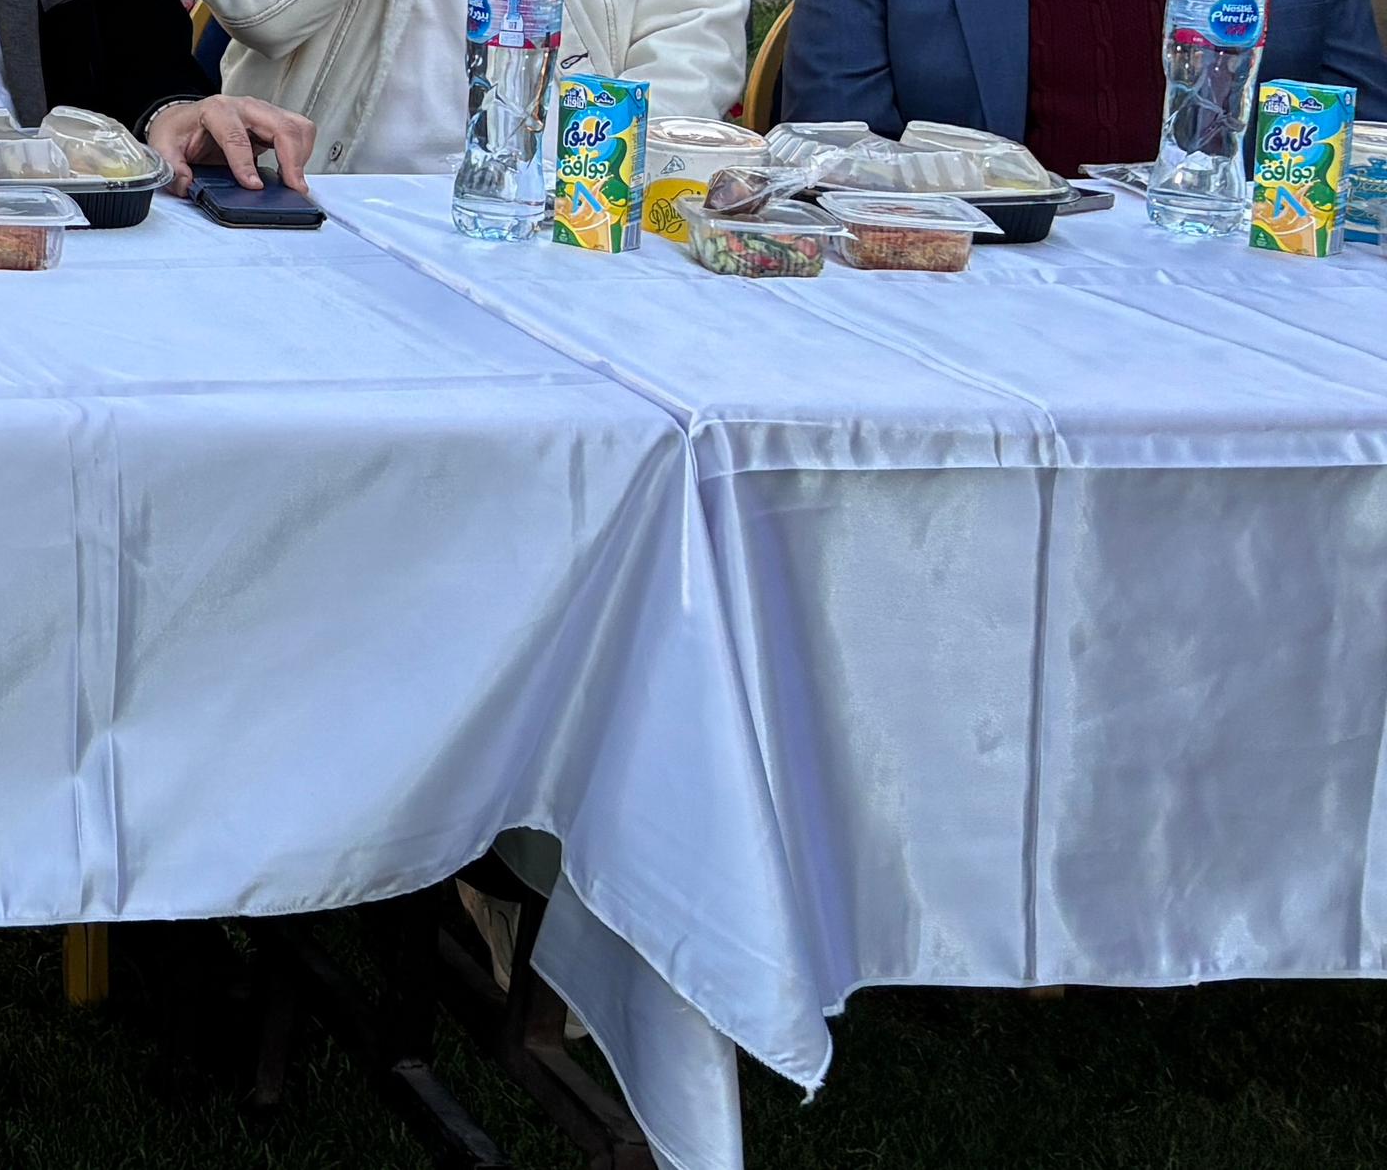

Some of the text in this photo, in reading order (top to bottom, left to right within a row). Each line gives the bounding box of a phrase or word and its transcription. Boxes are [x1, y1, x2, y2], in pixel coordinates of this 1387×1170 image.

[564, 120, 611, 147] كل يوم
[1264, 125, 1318, 152] كل يوم
[562, 153, 607, 179] جوافة
[1261, 158, 1312, 184] جوافة
